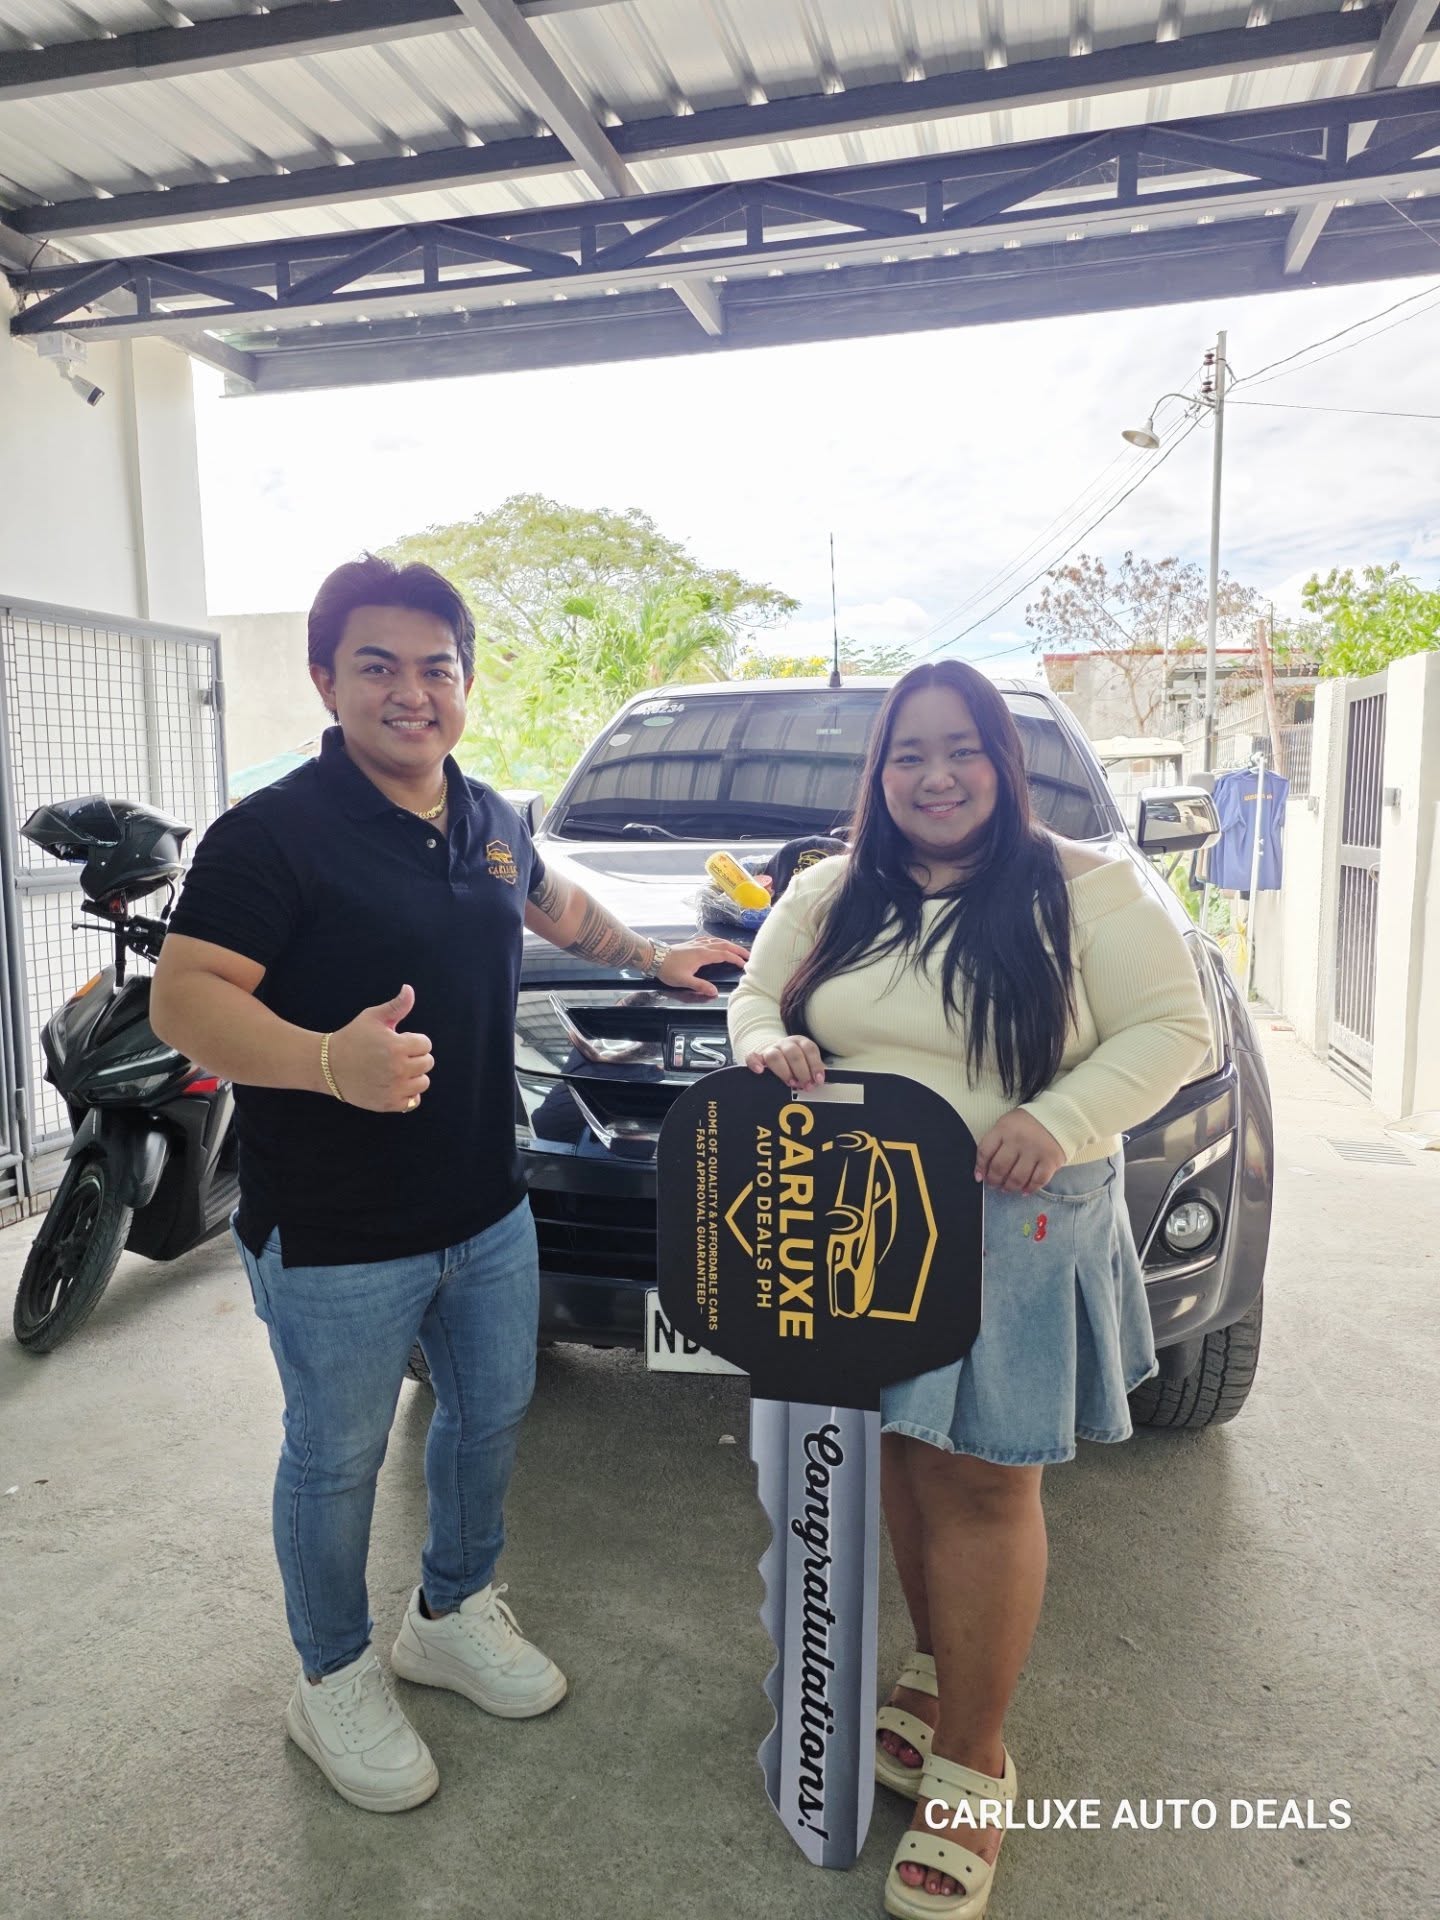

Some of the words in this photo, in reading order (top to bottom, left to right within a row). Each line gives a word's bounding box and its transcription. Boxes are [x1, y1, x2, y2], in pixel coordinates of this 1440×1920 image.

[673, 1035, 727, 1068] IS
[707, 1100, 718, 1136] HOME
[708, 1138, 718, 1154] OF
[756, 1125, 772, 1187] AUTO
[696, 1160, 706, 1223] APPROVAL
[708, 1156, 718, 1209] QUALITY
[708, 1210, 718, 1219] &
[756, 1196, 772, 1271] DEALS
[779, 1103, 814, 1340] CARLUXE
[708, 1221, 718, 1295] AFFORDABLE
[708, 1298, 718, 1331] CARS
[756, 1279, 772, 1308] PH
[791, 1423, 844, 1841] Congratulations!
